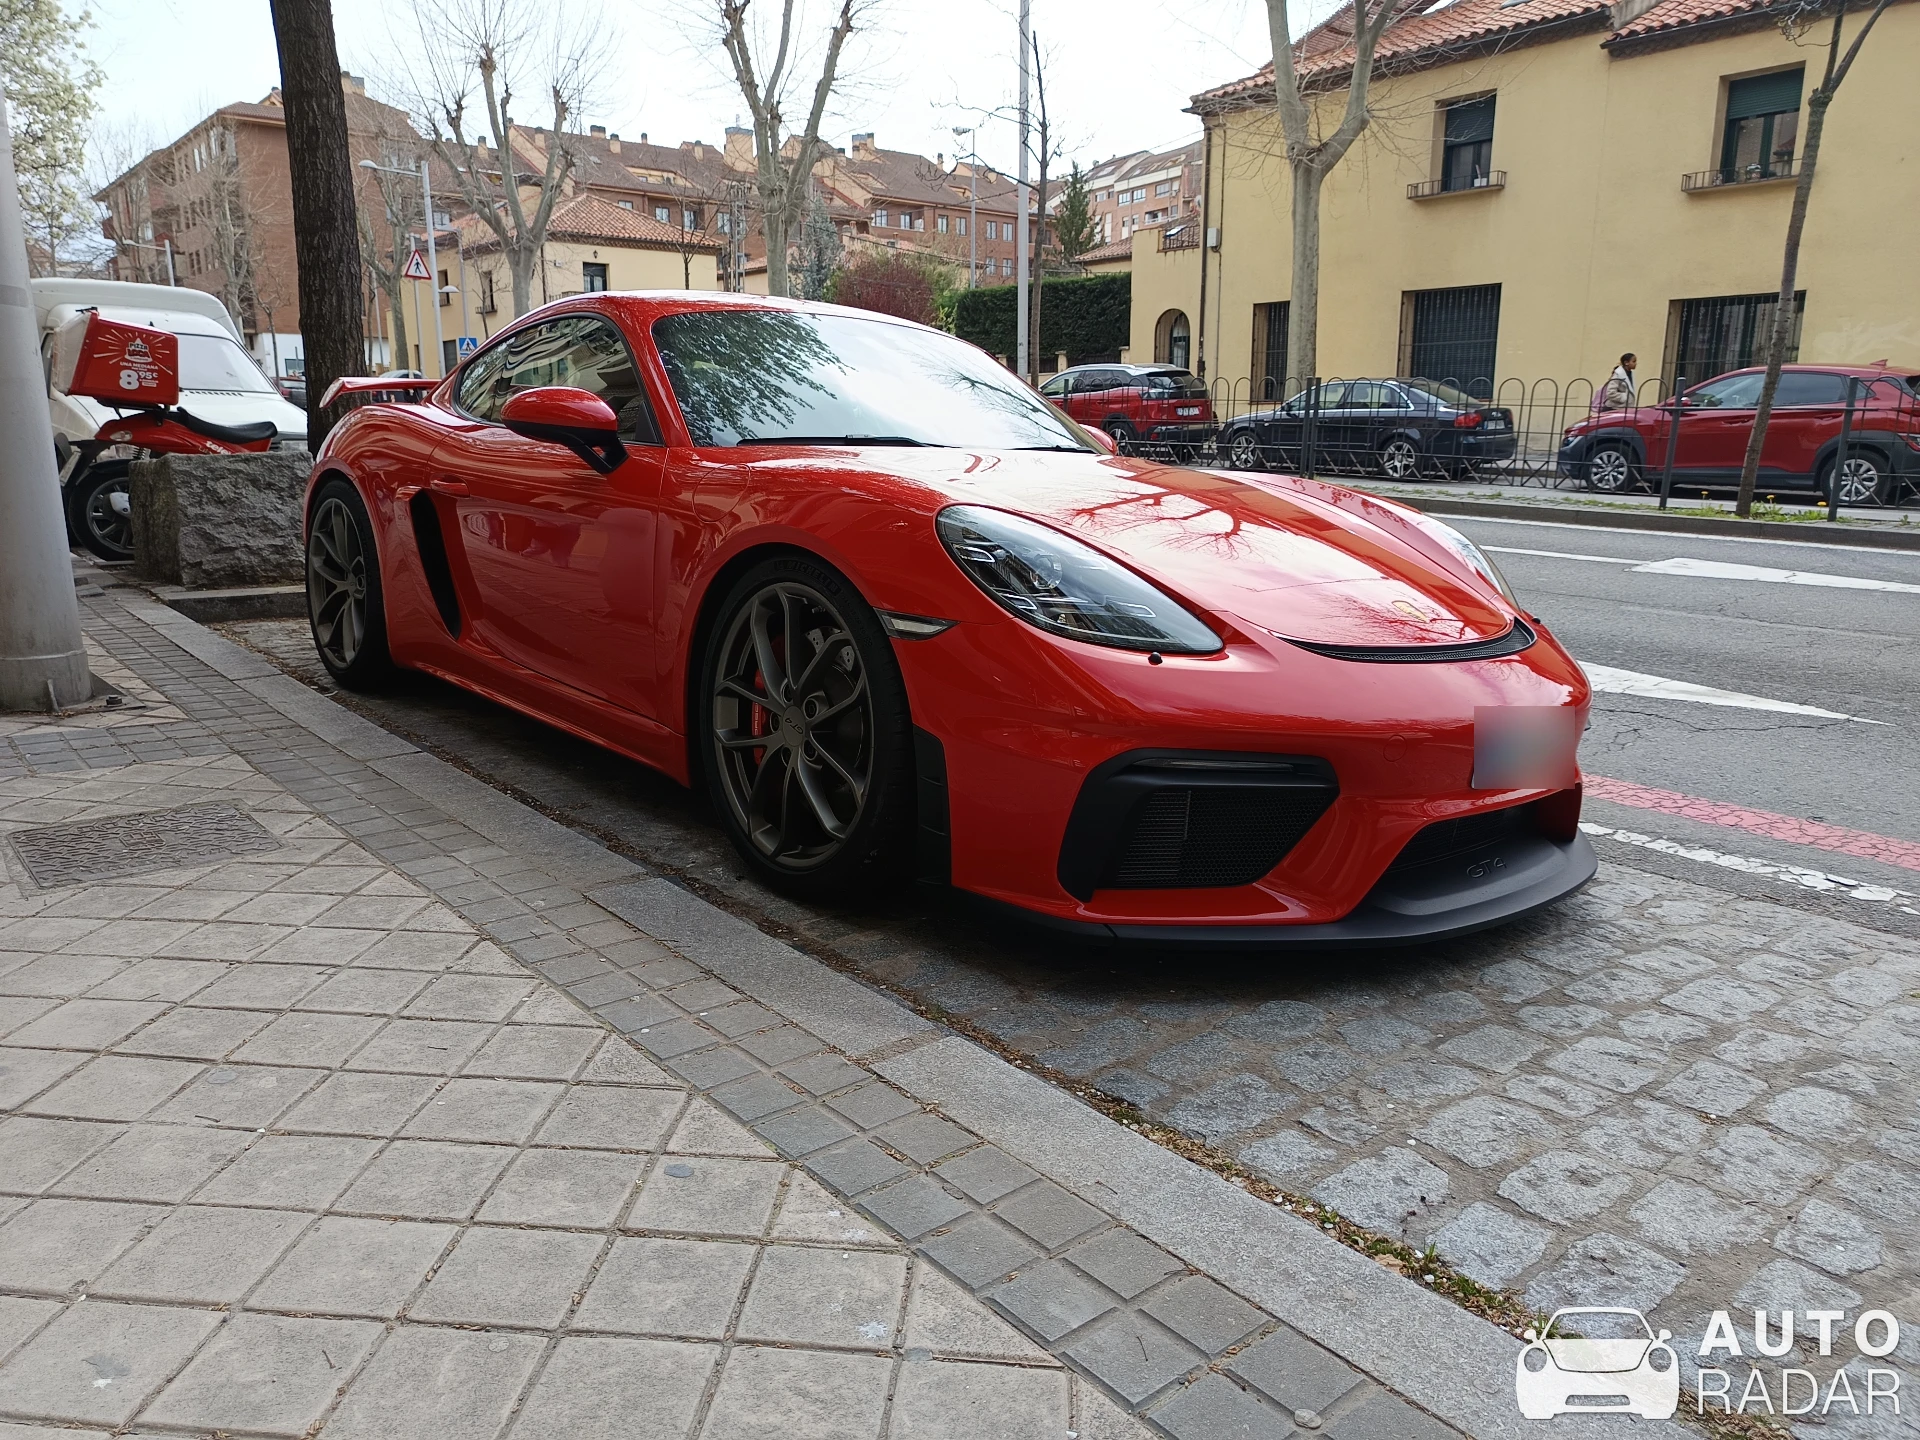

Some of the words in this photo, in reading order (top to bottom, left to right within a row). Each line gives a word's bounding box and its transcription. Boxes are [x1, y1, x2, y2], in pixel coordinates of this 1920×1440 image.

[133, 362, 158, 370] MEDIANA
[786, 560, 839, 594] MICHELIN
[784, 717, 804, 735] GT4
[1466, 857, 1507, 878] GT4
